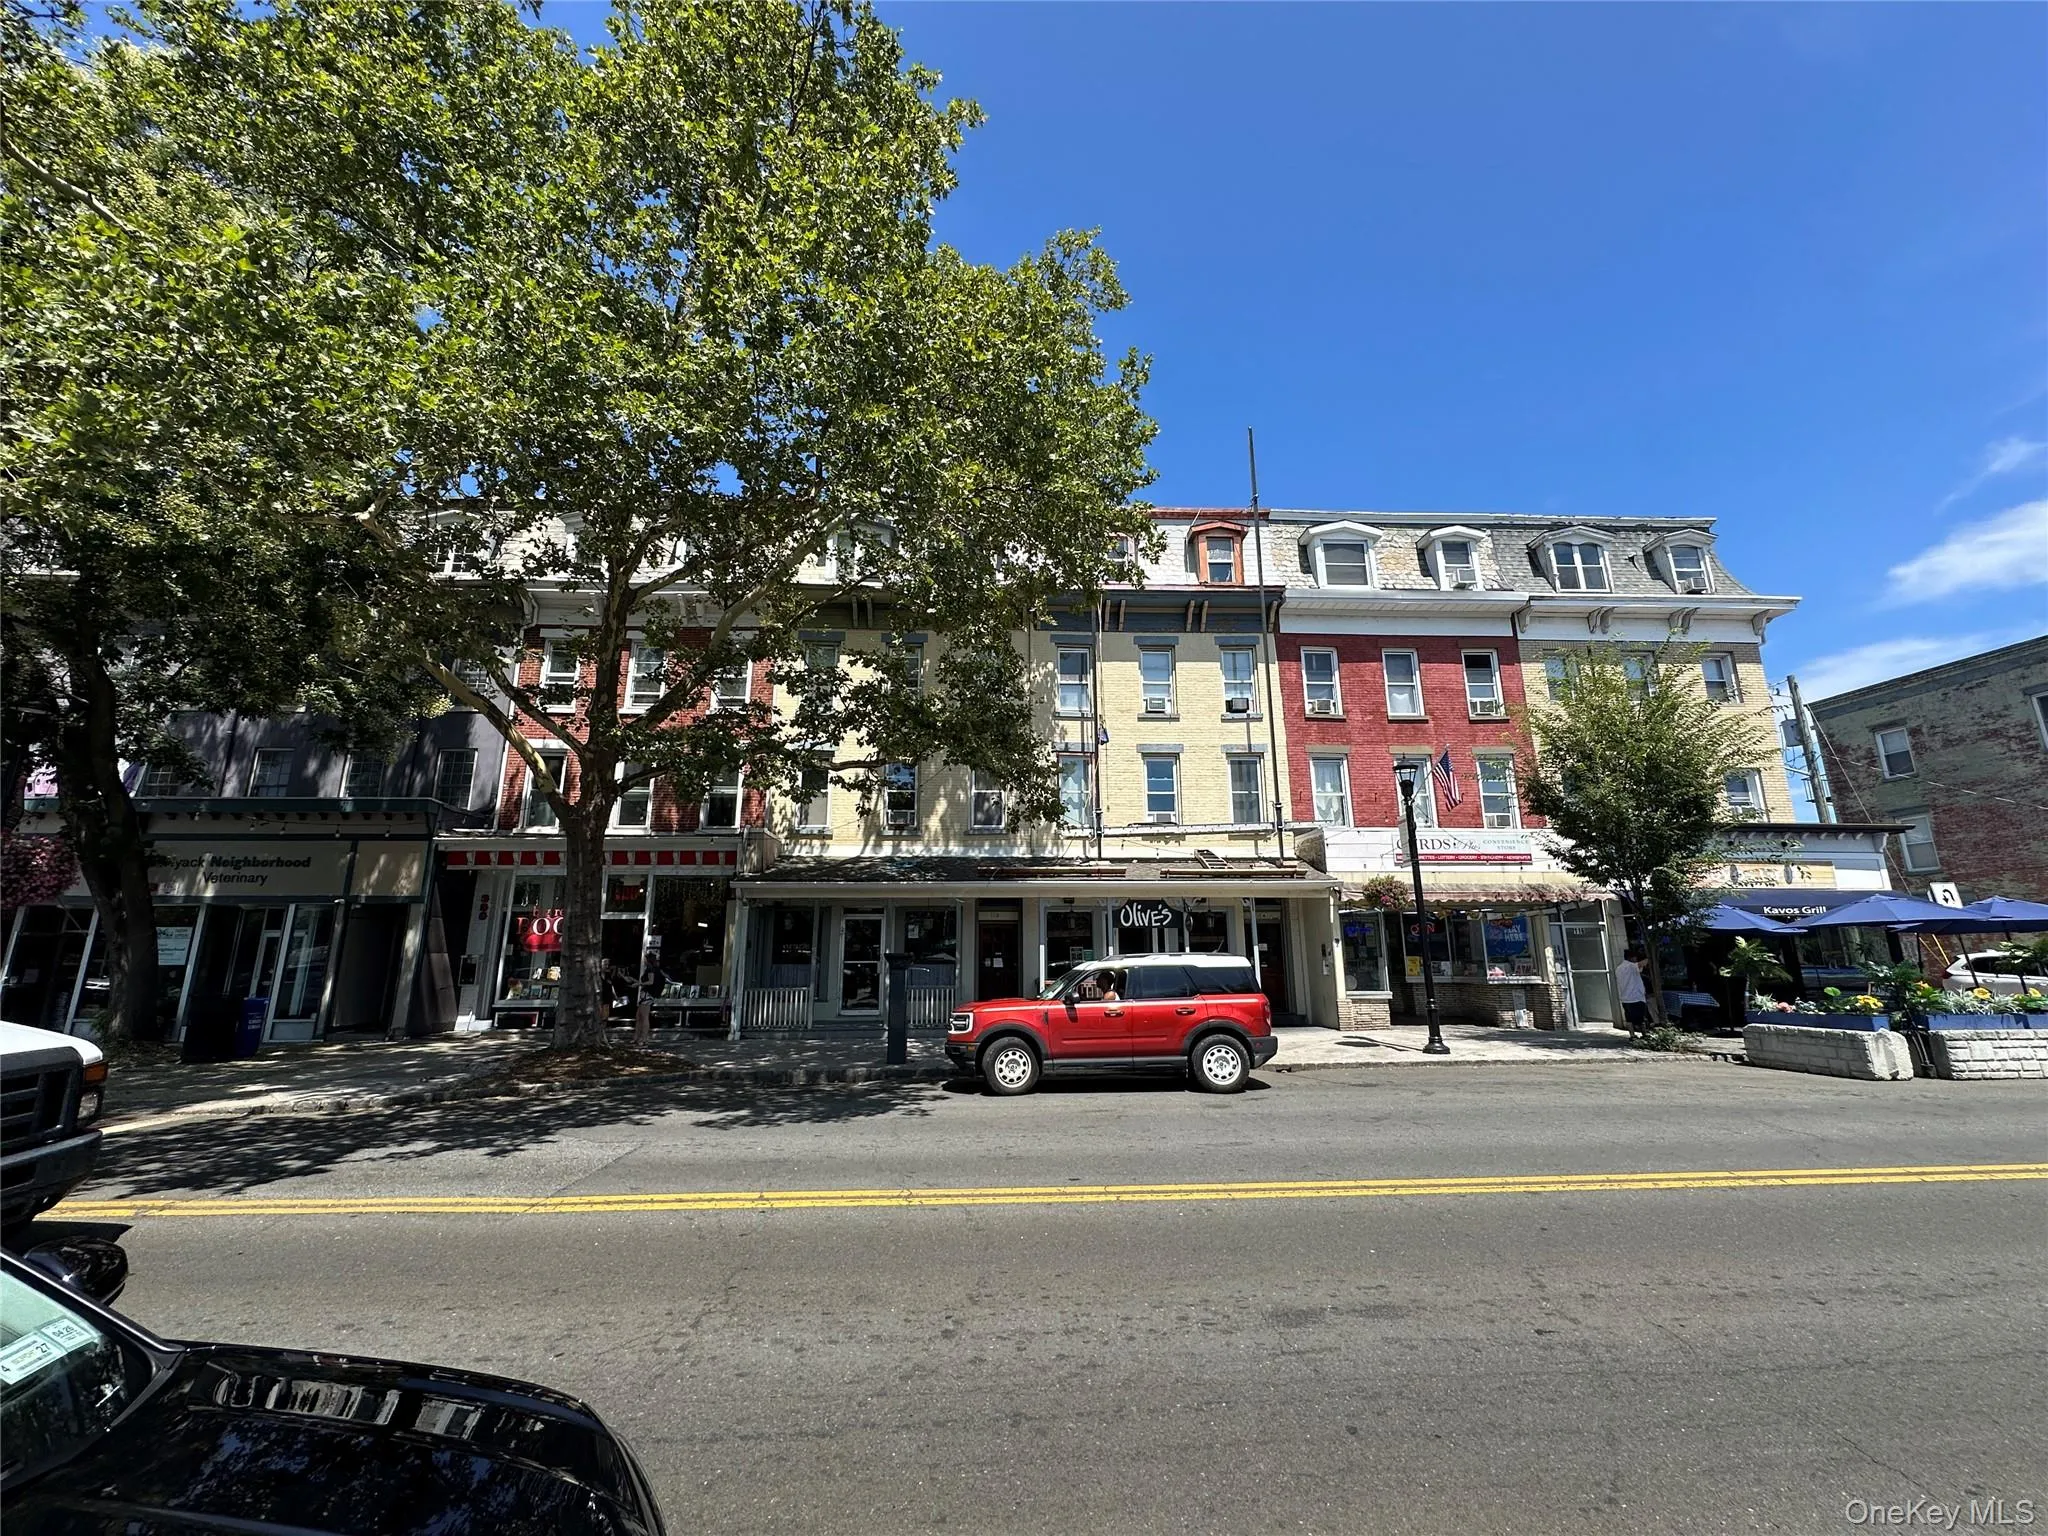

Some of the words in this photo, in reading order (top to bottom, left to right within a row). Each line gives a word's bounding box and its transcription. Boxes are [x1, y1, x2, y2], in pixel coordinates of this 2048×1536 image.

[1396, 838, 1451, 850] CRDS
[169, 856, 205, 870] yack
[210, 856, 312, 870] Neighborhood
[203, 871, 268, 886] Veterinary
[1763, 906, 1799, 914] Kavos
[1801, 906, 1827, 914] Grill
